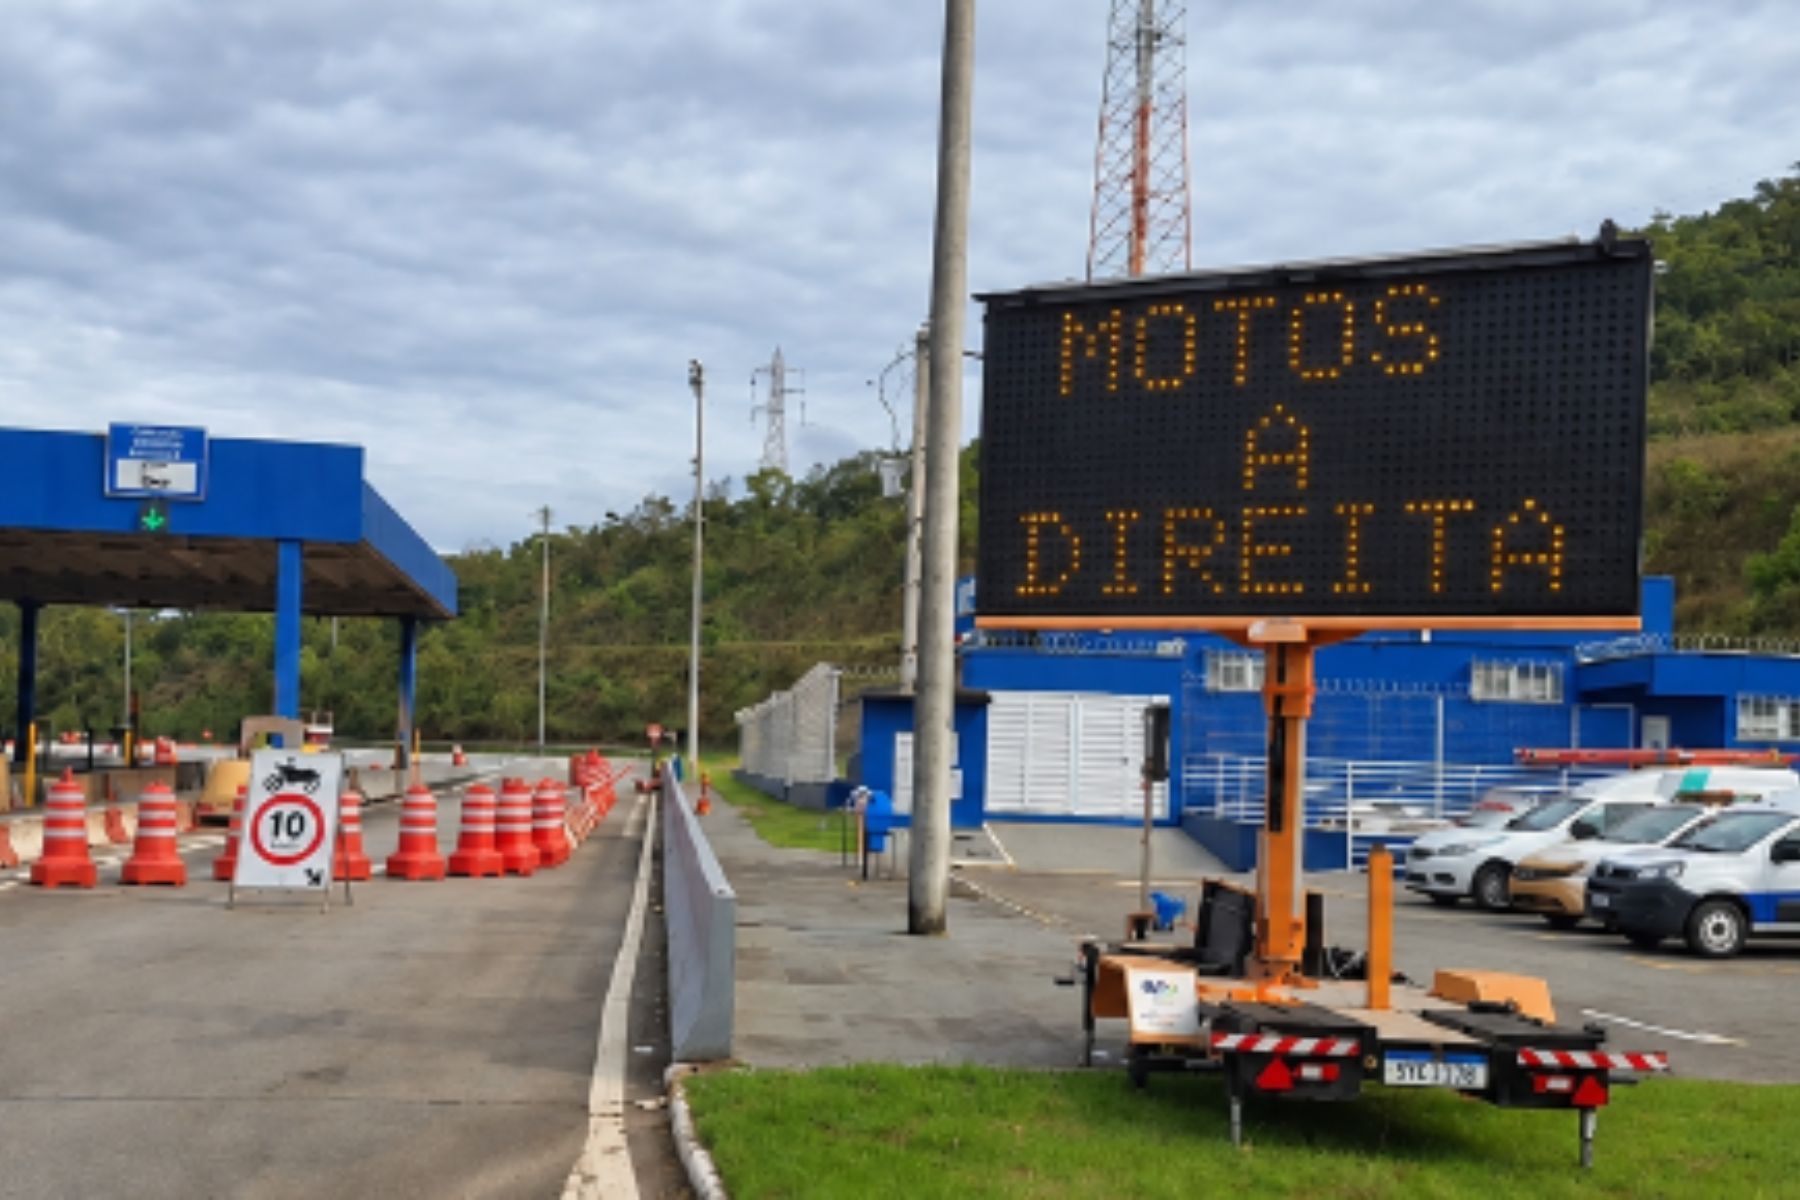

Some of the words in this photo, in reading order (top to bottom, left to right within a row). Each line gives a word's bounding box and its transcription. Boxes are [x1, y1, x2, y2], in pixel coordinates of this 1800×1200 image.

[1060, 284, 1440, 395] MOTOS
[1016, 498, 1565, 595] DIREITA
[270, 810, 305, 840] 10
